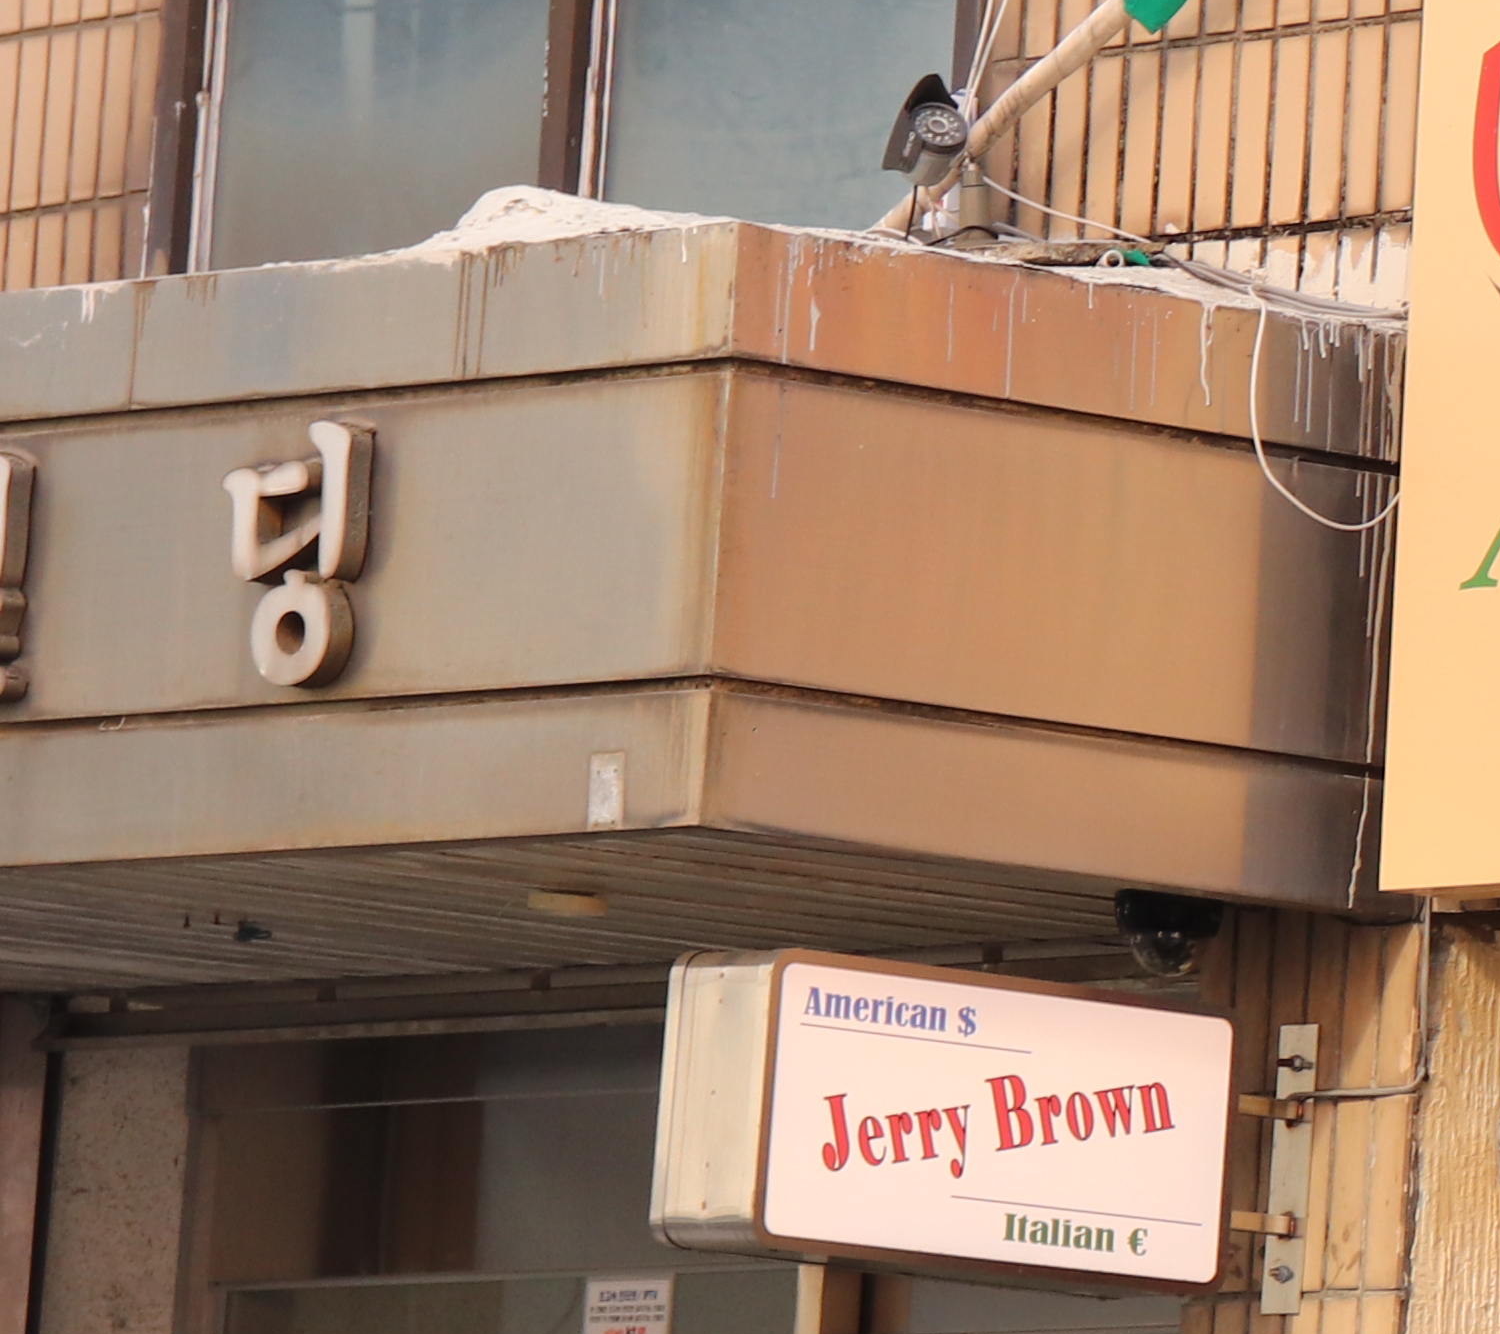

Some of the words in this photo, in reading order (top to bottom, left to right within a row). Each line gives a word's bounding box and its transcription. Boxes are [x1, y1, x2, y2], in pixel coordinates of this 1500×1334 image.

[803, 986, 947, 1033] American
[821, 1092, 972, 1179] Jerry
[984, 1073, 1176, 1152] Brown
[1003, 1212, 1116, 1254] Italian
